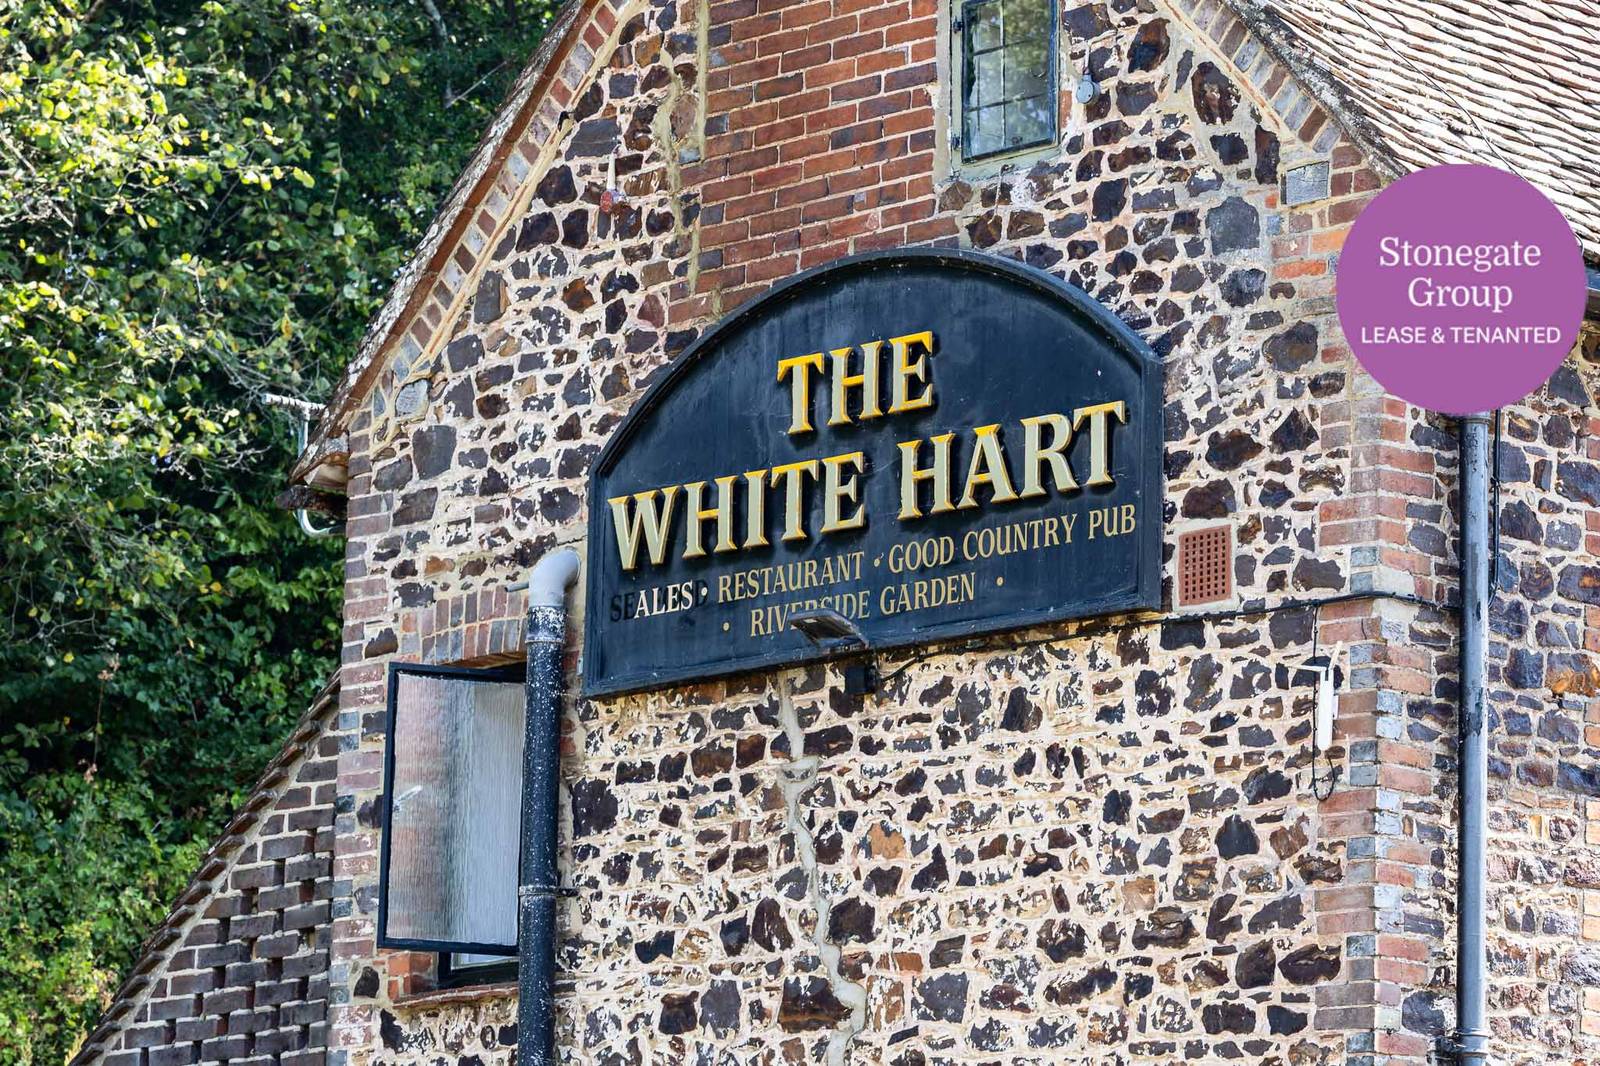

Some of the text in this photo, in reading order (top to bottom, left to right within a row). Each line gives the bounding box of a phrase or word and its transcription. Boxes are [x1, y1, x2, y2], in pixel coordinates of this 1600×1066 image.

[776, 331, 933, 435] THE
[607, 401, 1126, 571] WHITE HART
[718, 551, 865, 604] RESTAURANT
[888, 535, 955, 574] GOOD
[963, 514, 1077, 561] COUNTRY
[1088, 504, 1136, 539] PUB
[880, 572, 976, 616] GARDEN
